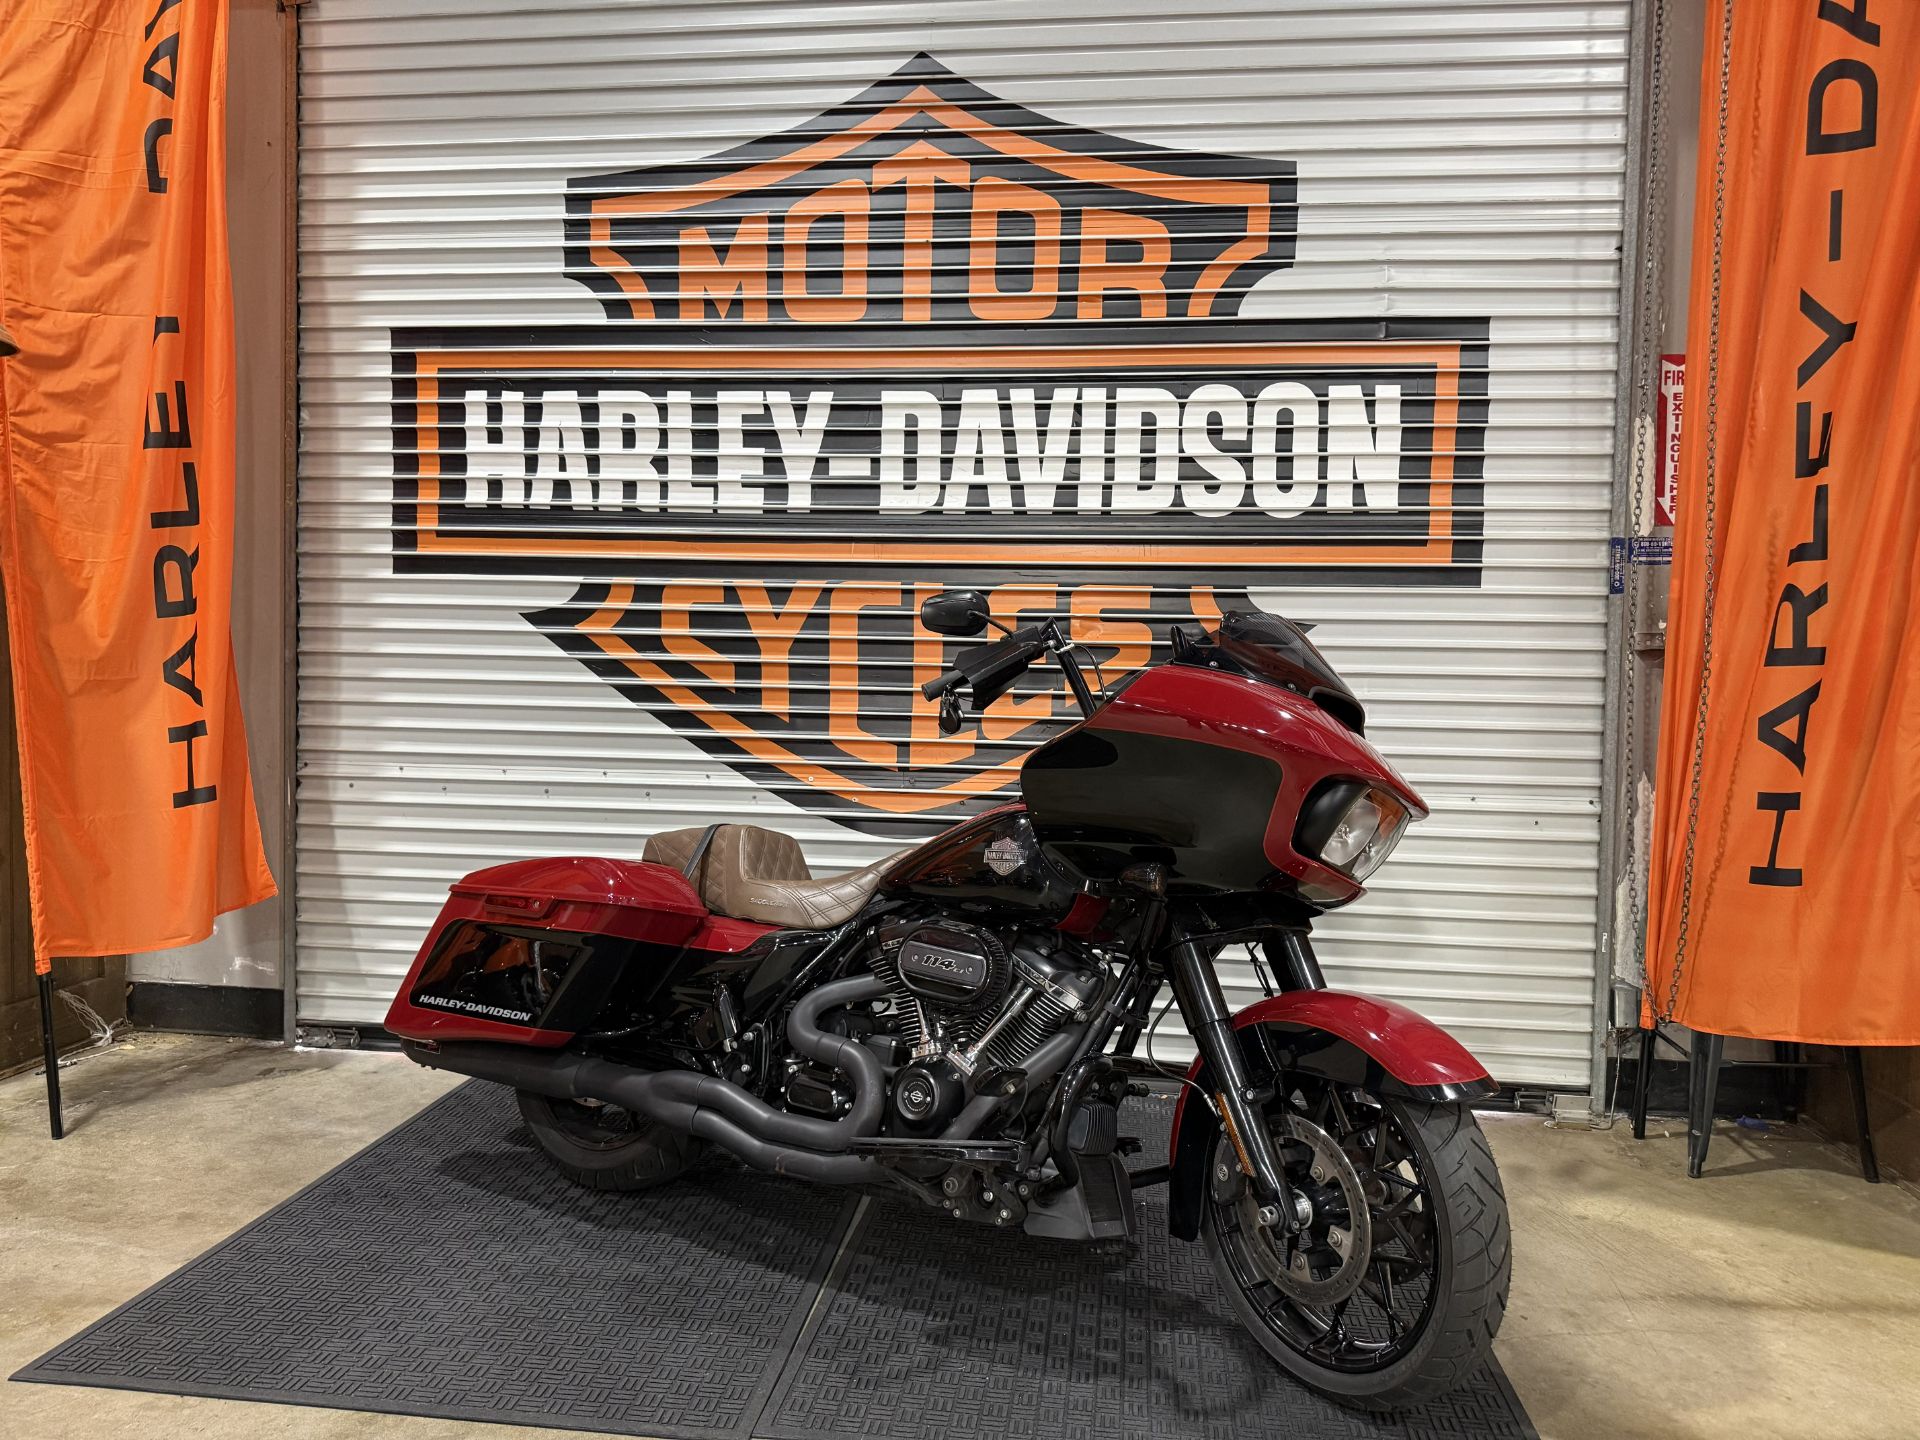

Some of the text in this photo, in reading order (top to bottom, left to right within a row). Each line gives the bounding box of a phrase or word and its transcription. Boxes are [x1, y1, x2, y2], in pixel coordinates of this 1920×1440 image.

[679, 140, 1171, 322] MOTOR
[1664, 370, 1684, 386] FIR
[465, 381, 1401, 518] HARLEY-DAVIDSON
[661, 579, 1153, 771] CYCLES
[922, 955, 956, 971] 114
[419, 994, 532, 1022] HARLEY-DAVIDSON
